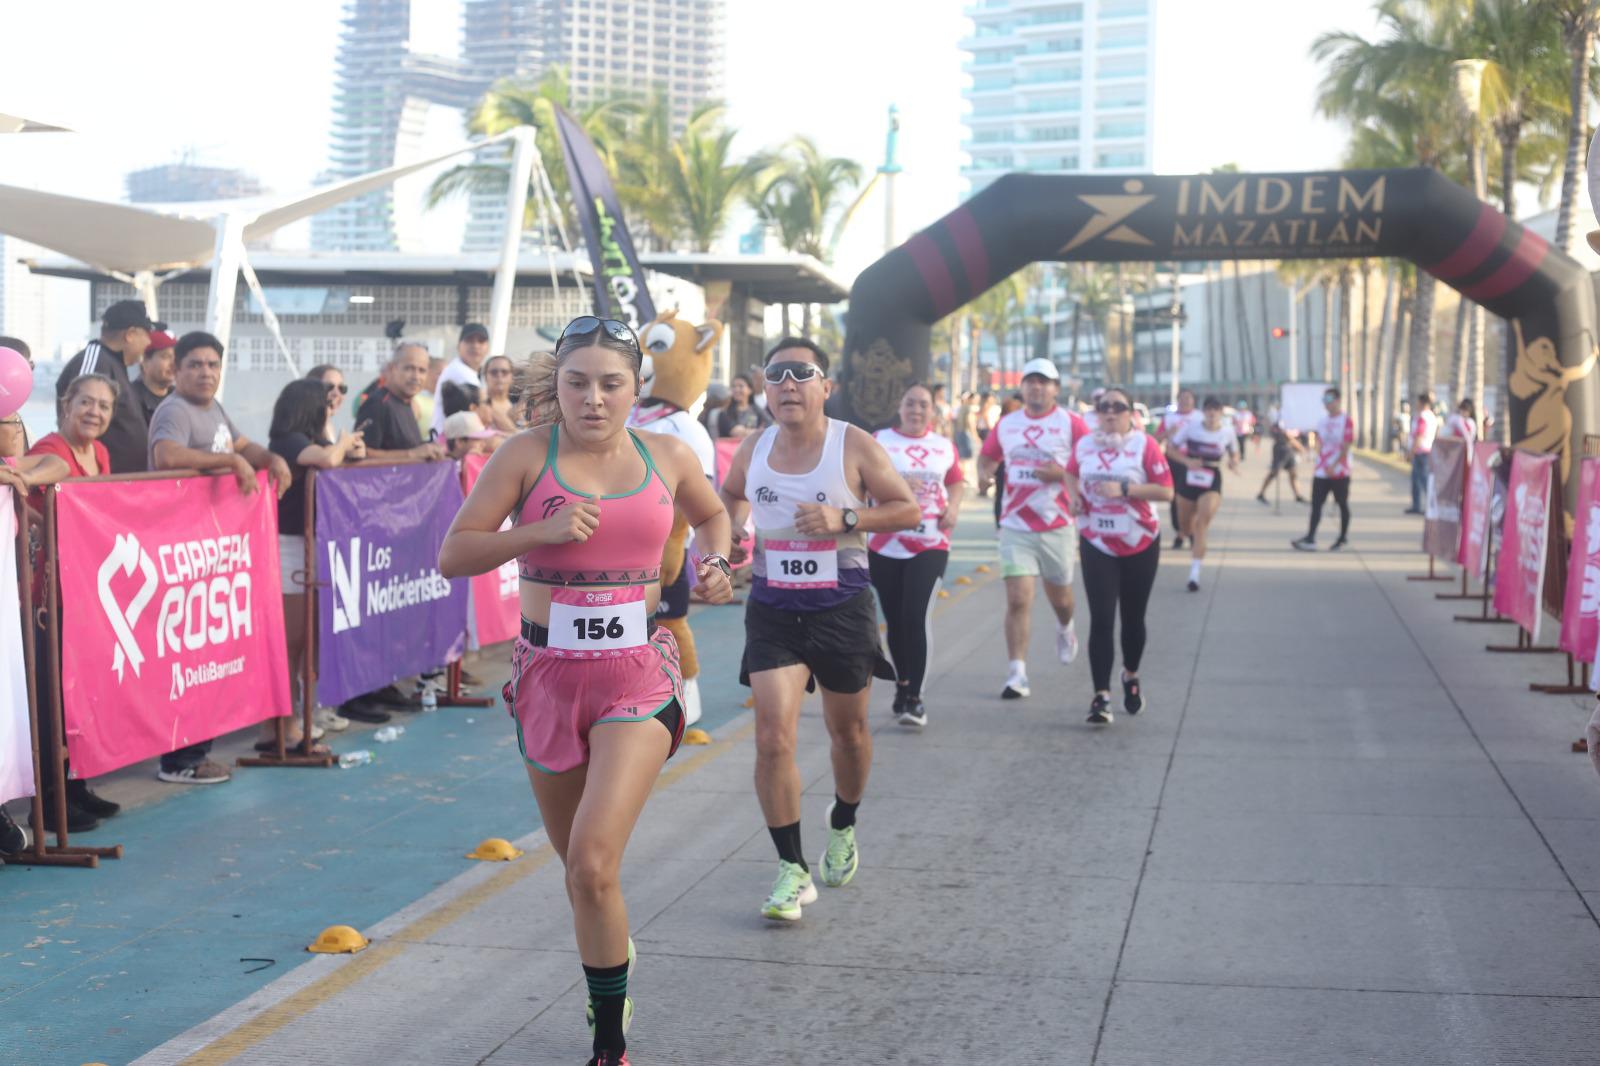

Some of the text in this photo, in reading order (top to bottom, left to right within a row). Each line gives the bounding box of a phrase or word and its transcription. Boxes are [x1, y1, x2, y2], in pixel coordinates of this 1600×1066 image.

[1177, 175, 1386, 216] IMDEM
[1172, 213, 1383, 246] MAZATLÁN
[158, 532, 252, 585] CARRERA
[367, 542, 392, 572] Los
[780, 559, 819, 576] 180
[366, 568, 452, 616] Noticieristas
[156, 571, 252, 658] ROSA
[573, 616, 624, 640] 156
